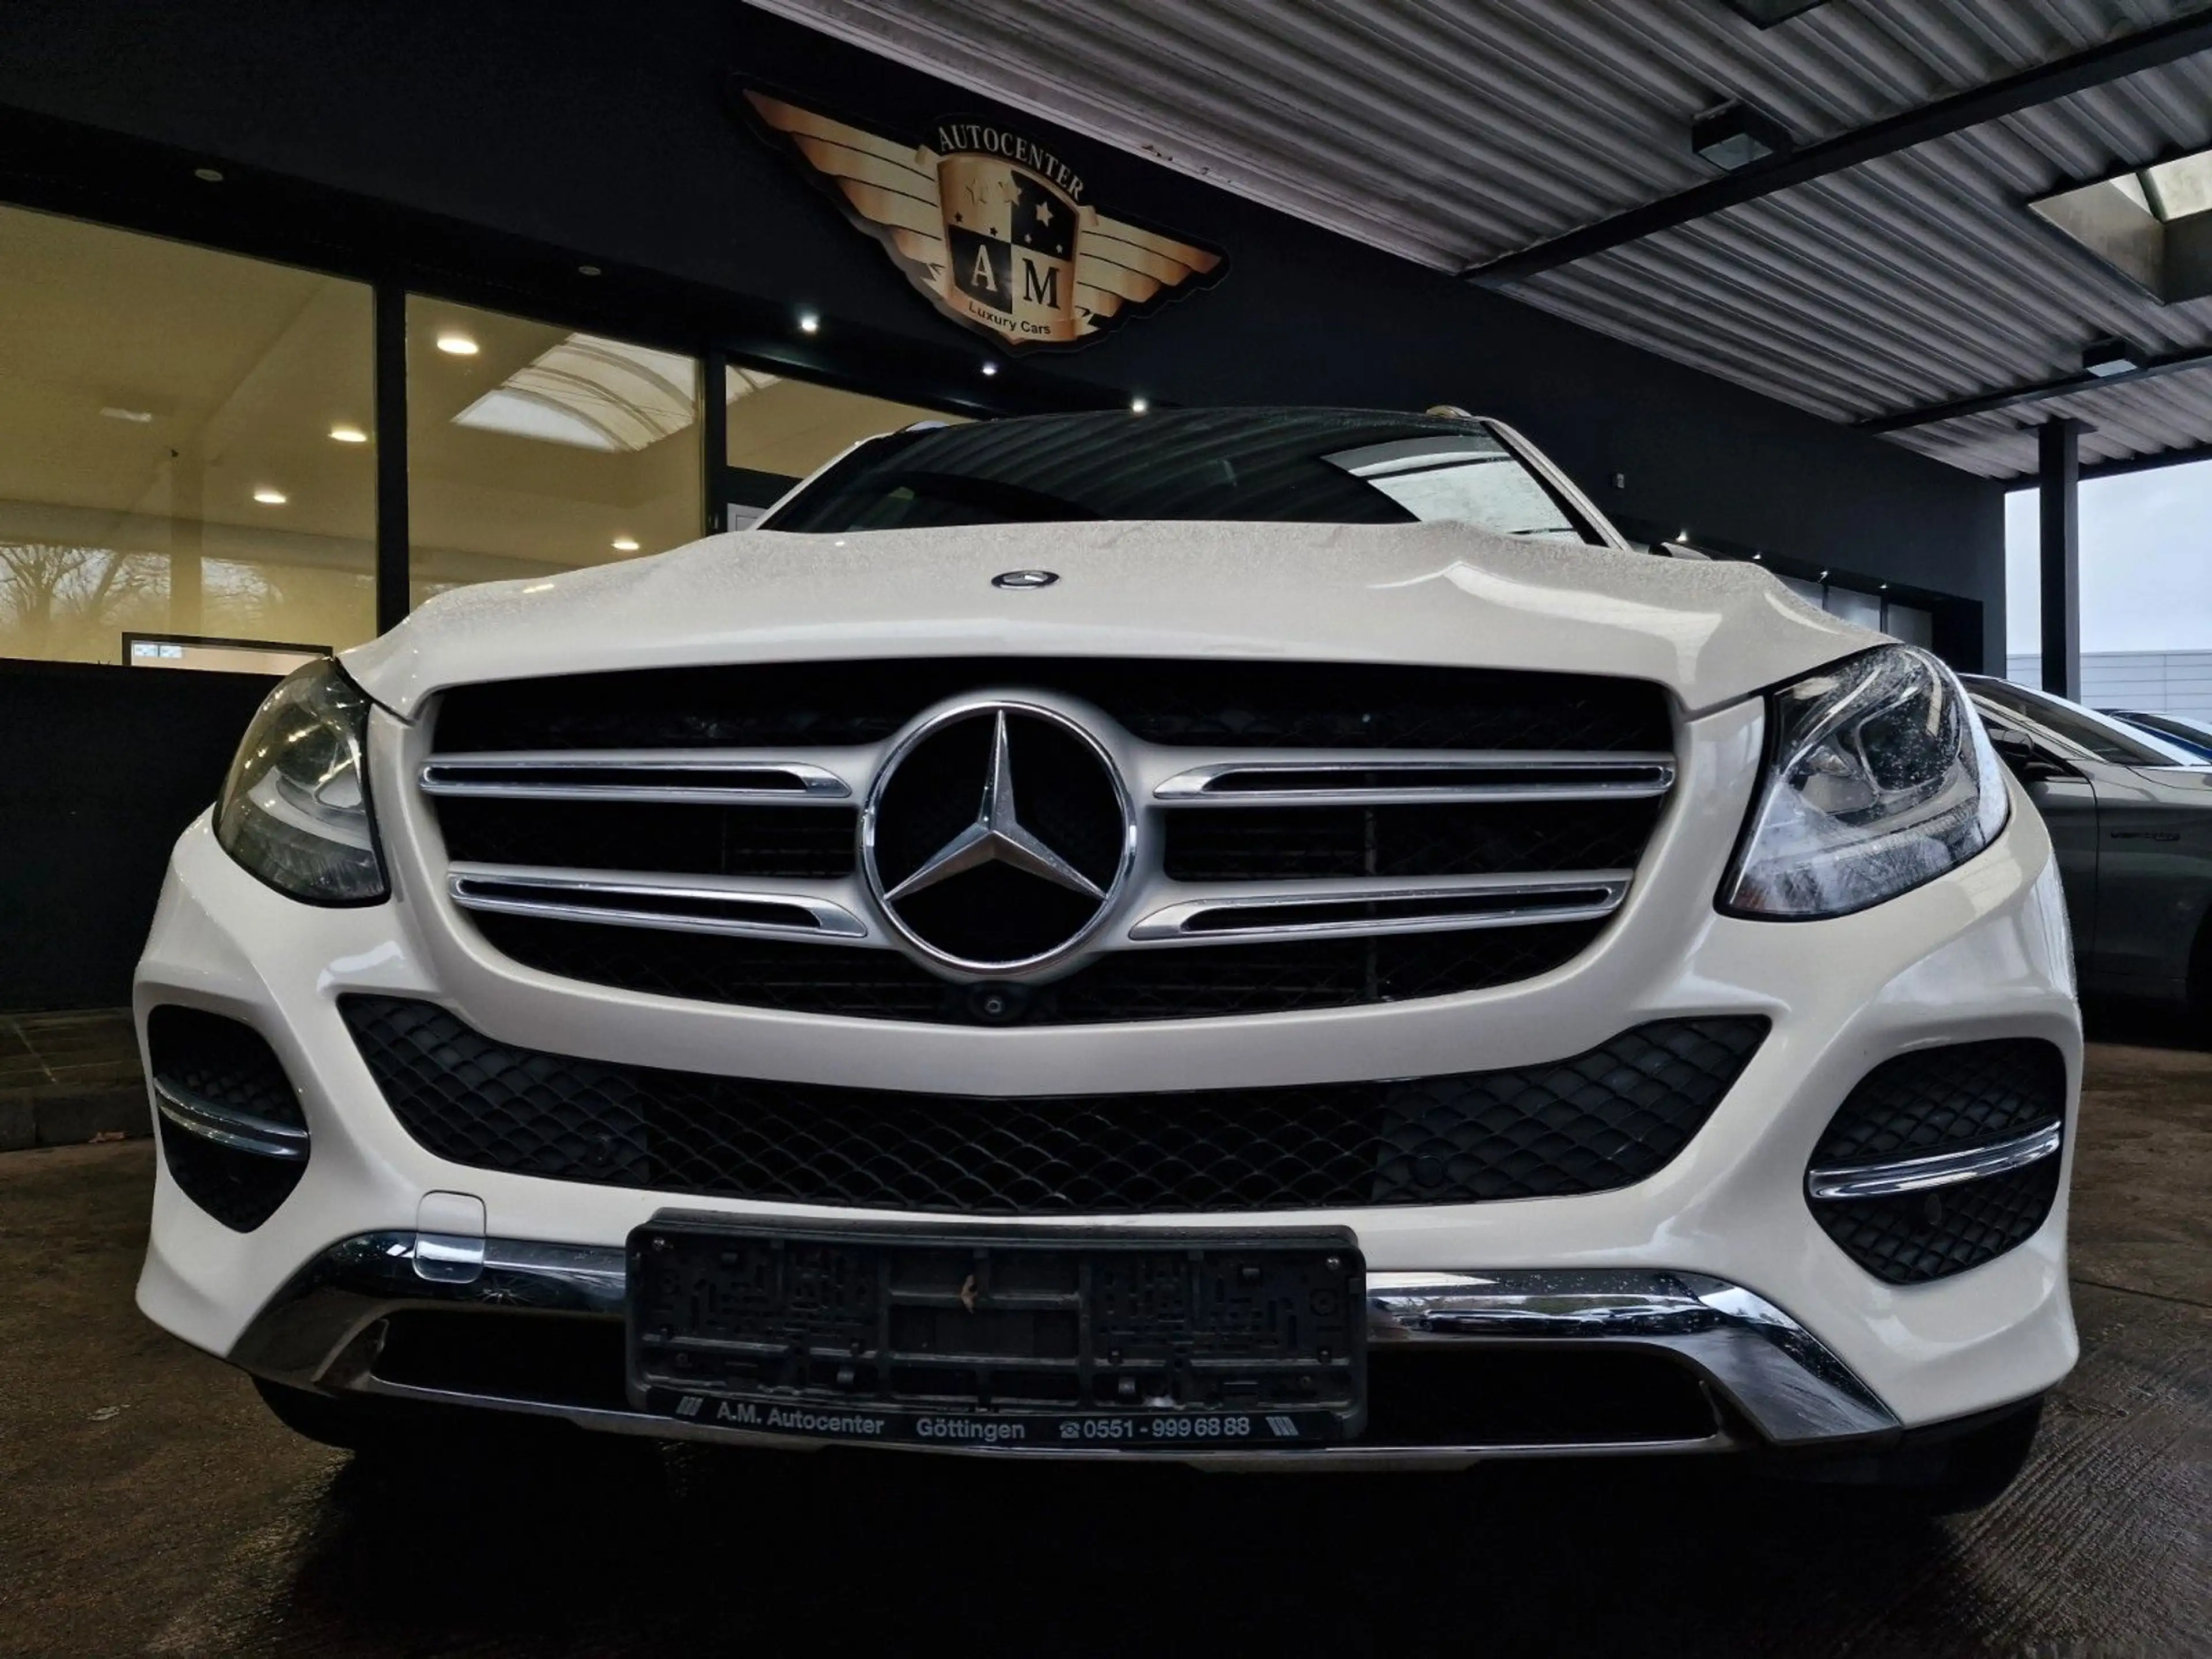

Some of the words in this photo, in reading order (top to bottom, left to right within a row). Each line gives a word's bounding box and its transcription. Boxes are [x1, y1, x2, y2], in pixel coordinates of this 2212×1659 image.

[938, 124, 1084, 202] AUTOCENTER
[968, 301, 1017, 332] Luxury
[1021, 320, 1051, 335] Cars
[717, 1402, 762, 1424] A.M.
[766, 1407, 885, 1434] Autocenter
[916, 1418, 1025, 1442] Göttingen
